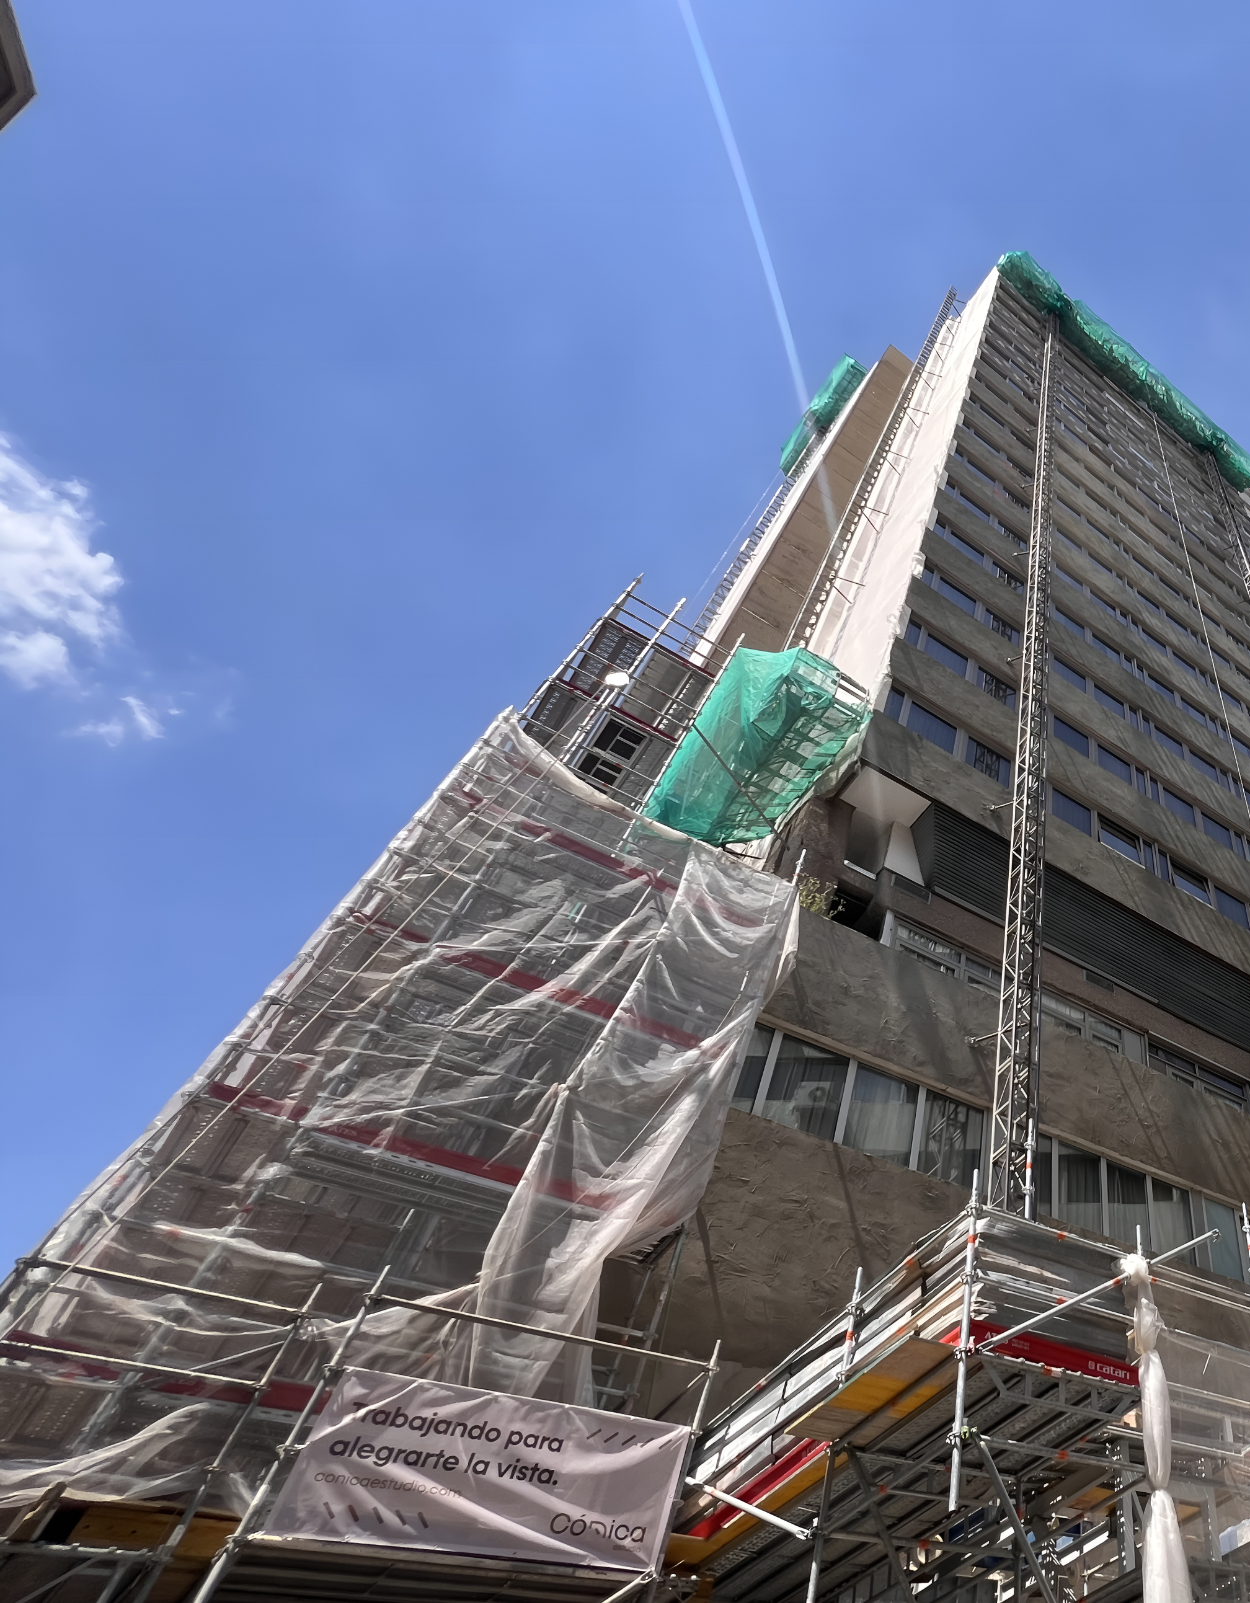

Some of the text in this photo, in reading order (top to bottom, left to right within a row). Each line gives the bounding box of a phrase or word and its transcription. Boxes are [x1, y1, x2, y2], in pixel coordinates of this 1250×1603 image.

[1096, 1362, 1130, 1380] catari
[353, 1401, 565, 1453] Trabajando para
[329, 1435, 559, 1486] alegrarte la vista.
[549, 1512, 647, 1543] Cónica
